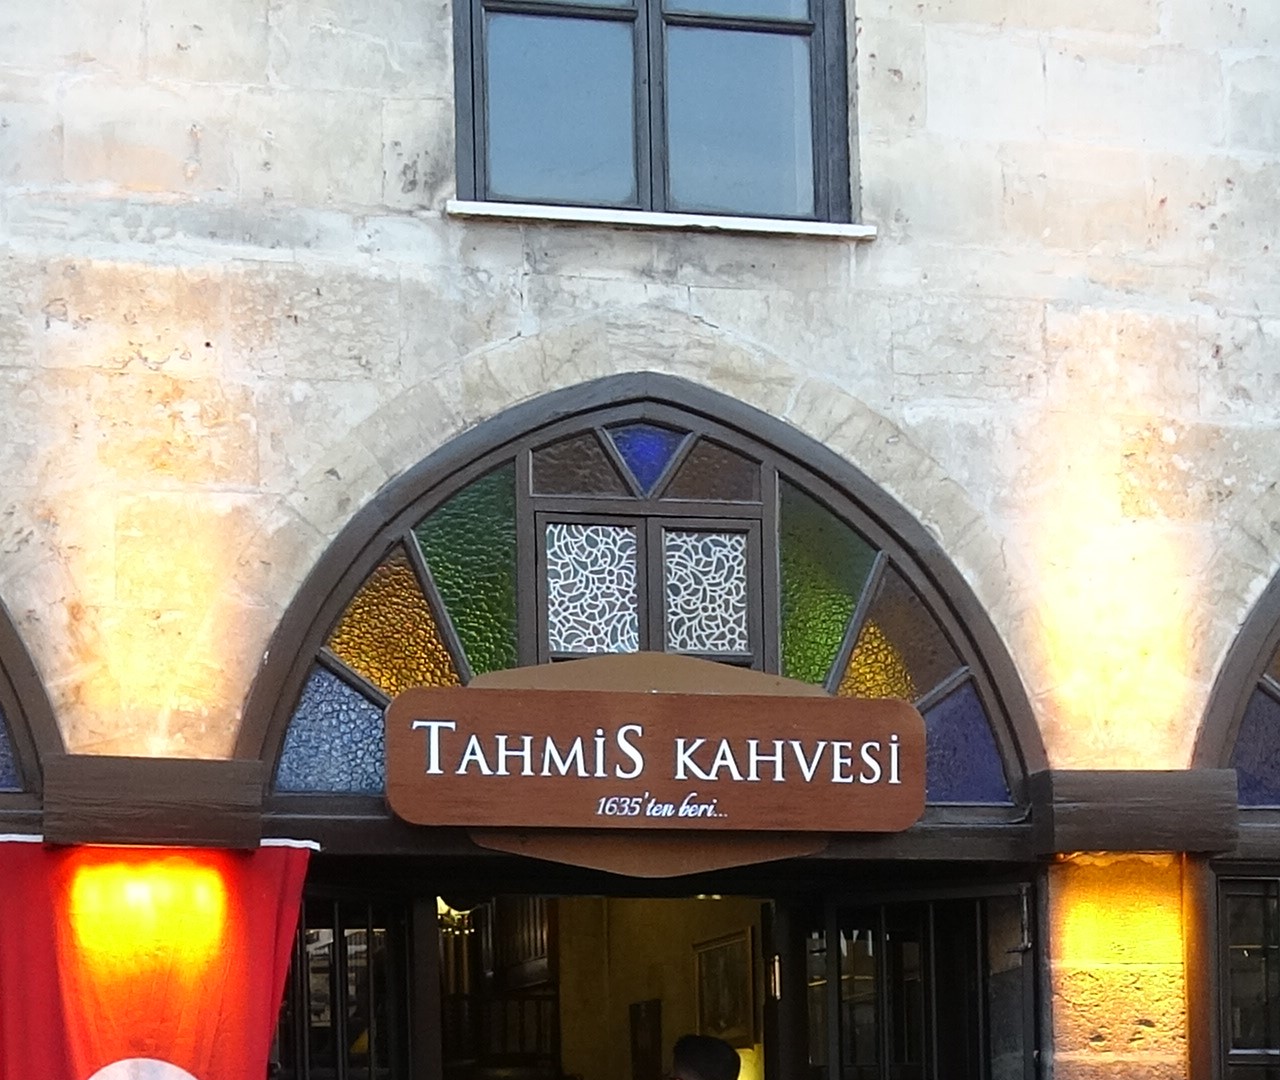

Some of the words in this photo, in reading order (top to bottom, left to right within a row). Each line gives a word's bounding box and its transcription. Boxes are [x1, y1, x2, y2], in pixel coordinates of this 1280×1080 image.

[411, 719, 645, 781] TAHMİS
[674, 733, 902, 785] KAHVESİ
[595, 791, 674, 818] 1635'ten
